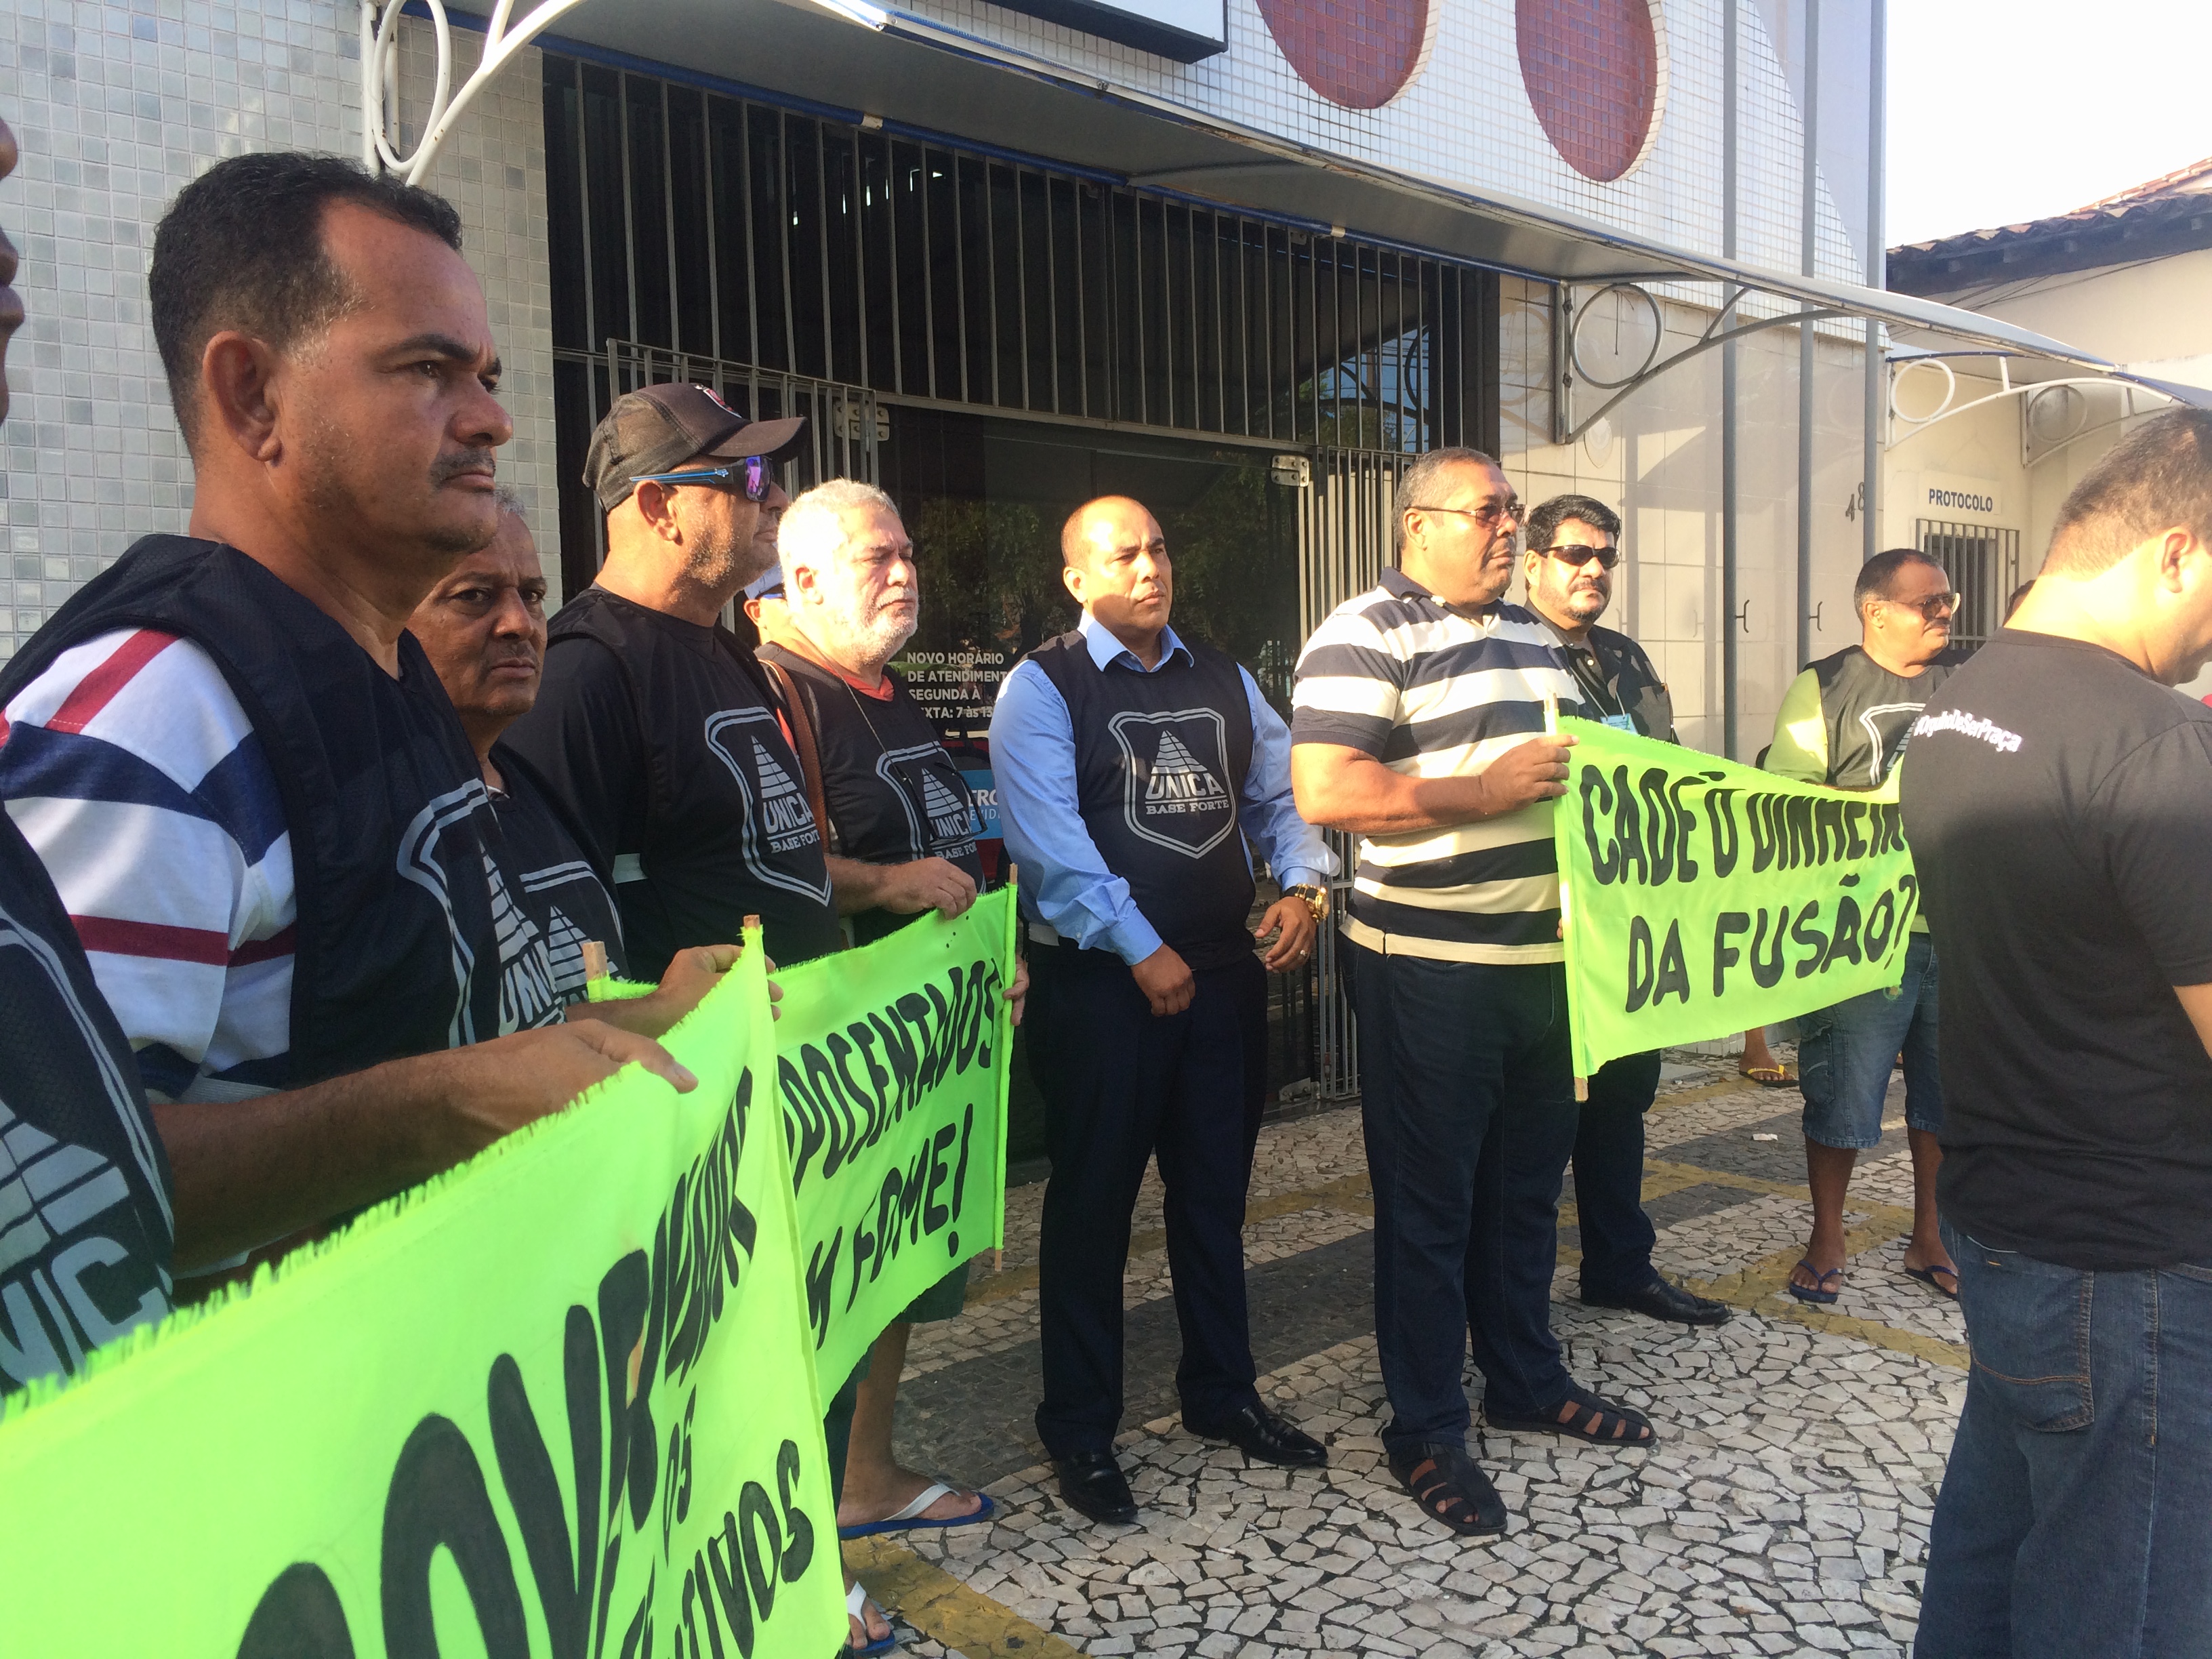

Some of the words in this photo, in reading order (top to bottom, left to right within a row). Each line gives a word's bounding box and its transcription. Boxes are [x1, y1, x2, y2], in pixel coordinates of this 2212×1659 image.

[1929, 489, 1993, 512] PROTOCOLO
[907, 652, 945, 664] NOVO
[949, 651, 1004, 664] HORÁRIO
[907, 670, 925, 682] DE
[928, 671, 1008, 682] ATENDIMENT
[908, 689, 969, 701] SEGUNDA
[920, 707, 954, 718] XTA:
[956, 707, 964, 718] 7
[1145, 773, 1225, 800] UNICA
[763, 792, 815, 834] UNICA
[1146, 803, 1186, 815] BASE
[1189, 799, 1229, 812] FORTE
[770, 836, 802, 854] BASE
[1746, 792, 1905, 874] DINHEIR
[1625, 914, 1690, 1013] DA
[1713, 872, 1917, 998] FUSÃO?
[777, 957, 1003, 1201] POSENTADOS
[846, 1103, 974, 1315] FOME!
[674, 1439, 815, 1659] TIVOS
